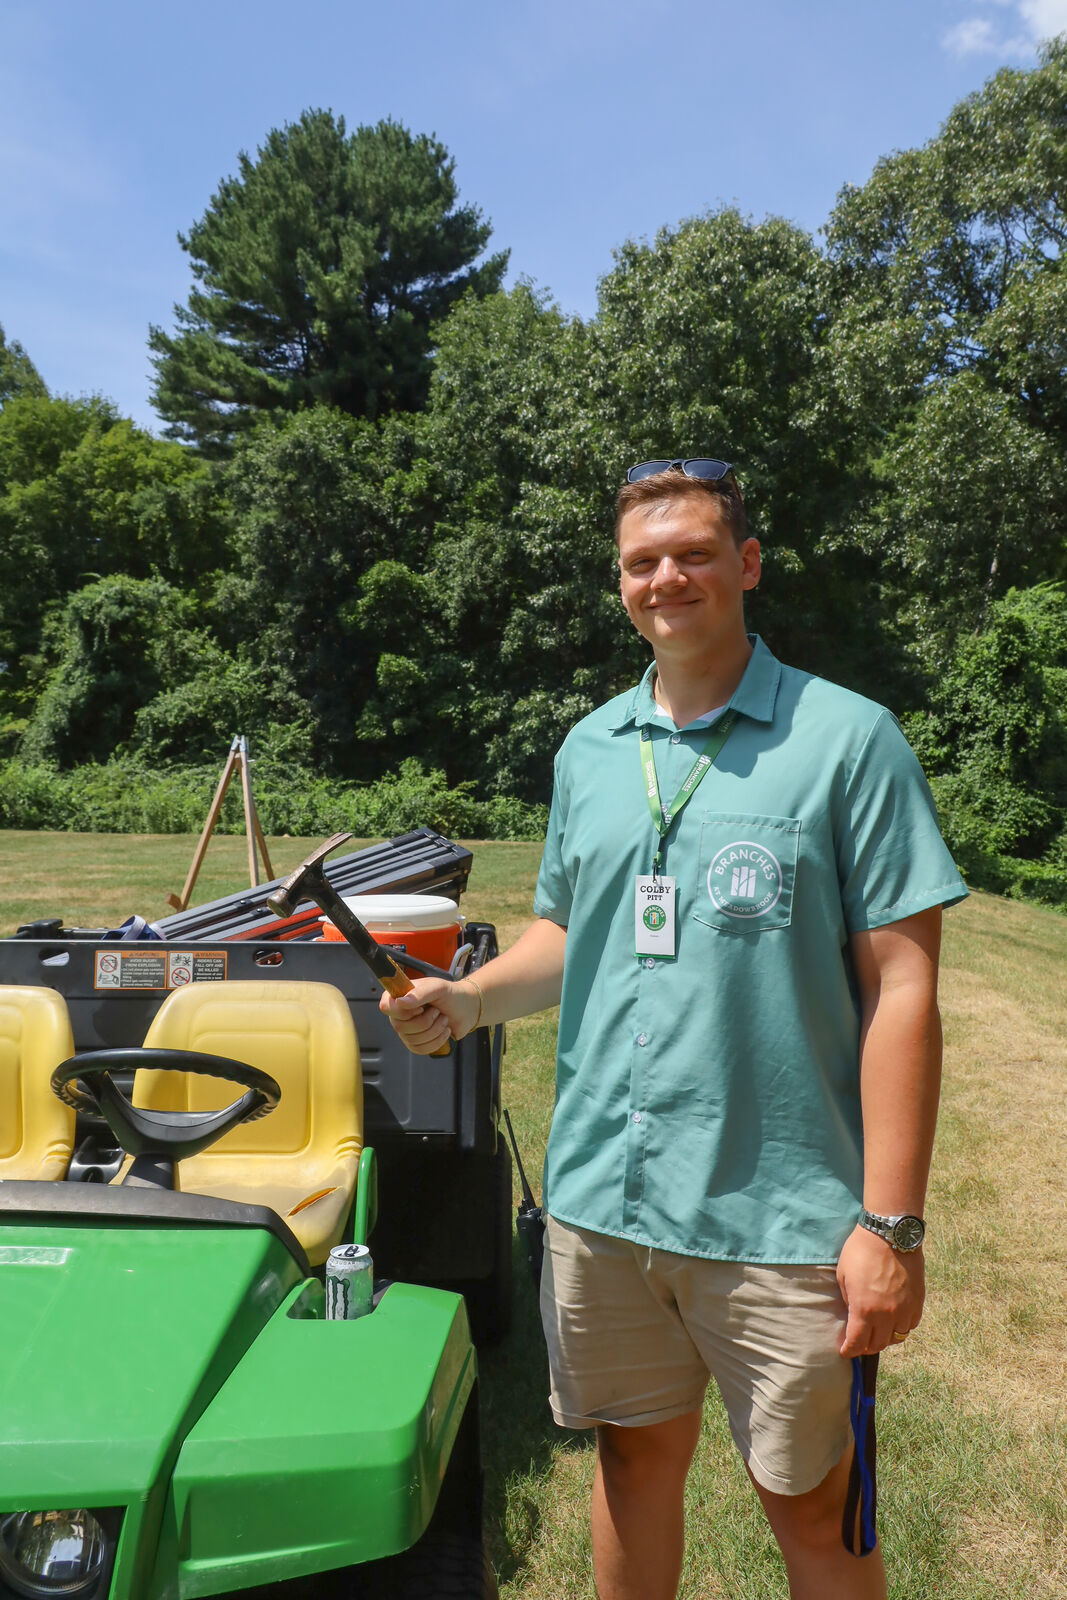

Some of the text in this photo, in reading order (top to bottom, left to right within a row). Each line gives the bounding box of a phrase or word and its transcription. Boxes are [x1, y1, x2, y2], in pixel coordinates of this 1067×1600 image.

[714, 848, 777, 881] BRANCHES
[640, 885, 671, 894] COLBY
[713, 886, 774, 913] AT MEADOWBROOK
